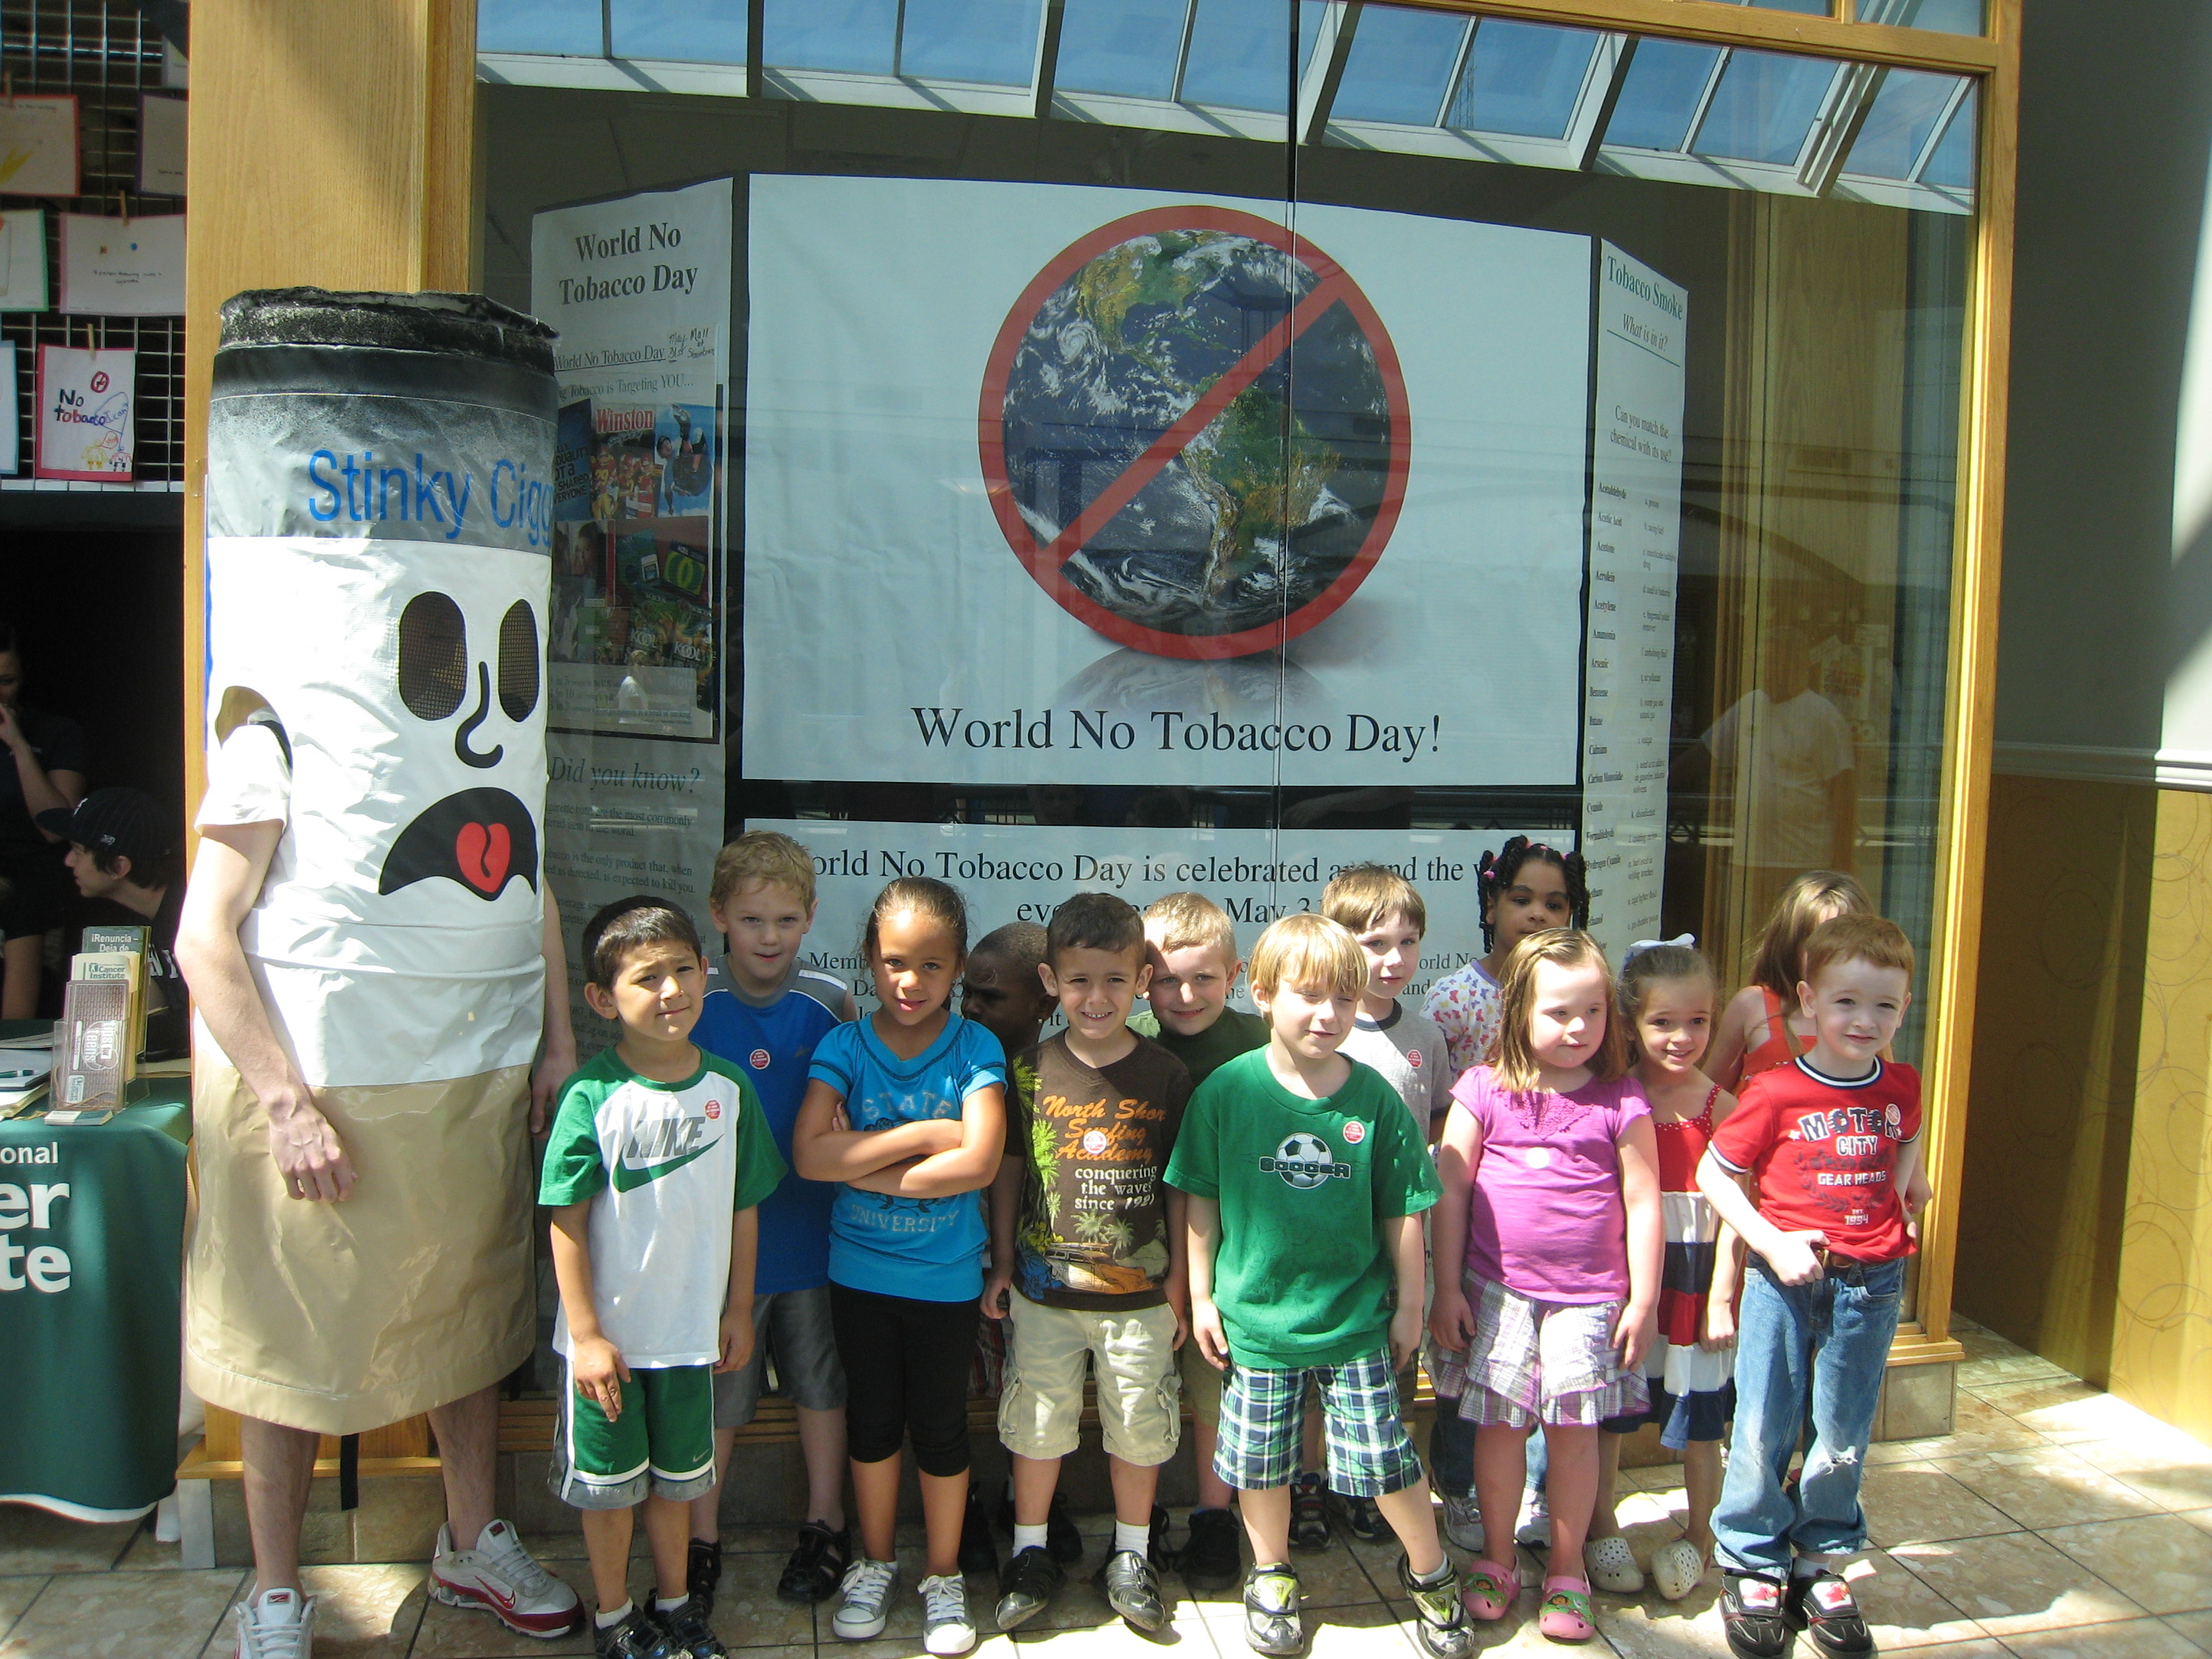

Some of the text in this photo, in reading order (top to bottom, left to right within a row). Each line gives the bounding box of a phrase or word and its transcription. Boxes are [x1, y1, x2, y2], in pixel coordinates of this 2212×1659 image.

[575, 222, 680, 262] World No
[559, 264, 698, 305] Tobacco Day
[1607, 256, 1683, 320] Tobacco Smoke
[1622, 313, 1669, 351] What is in it?
[554, 345, 666, 370] World No Tobacco Day
[59, 388, 84, 408] No
[570, 381, 604, 398] Tobacco
[607, 381, 614, 394] is
[617, 377, 659, 395] Targeting
[595, 408, 655, 432] Winston
[1615, 405, 1628, 423] Can
[1629, 411, 1640, 429] you
[1609, 428, 1637, 452] chemical
[308, 449, 471, 539] Stinky
[673, 641, 701, 662] KOOL
[910, 706, 1441, 764] World No Tobacco Day!
[552, 757, 701, 793] Did you know?
[595, 854, 613, 868] only
[616, 857, 647, 871] product
[813, 848, 869, 876] orld
[878, 849, 926, 878] No
[935, 852, 1064, 881] Tobacco
[1072, 854, 1128, 890] Day
[1142, 855, 1167, 882] is
[1175, 853, 1320, 884] celebrated
[1426, 856, 1464, 882] the
[613, 873, 649, 887] expected
[651, 877, 660, 888] to
[662, 878, 676, 890] kill
[1419, 953, 1451, 971] orld
[863, 1090, 954, 1120] STATE
[1043, 1095, 1107, 1118] North
[626, 1117, 706, 1159] NIKE
[1836, 1136, 1879, 1156] CITY
[0, 1141, 59, 1164] onal
[1074, 1164, 1158, 1186] conquering
[1817, 1170, 1887, 1186] GEAR HEADS
[1080, 1179, 1153, 1196] the waves
[0, 1182, 71, 1230] er
[1074, 1195, 1115, 1211] since
[851, 1203, 960, 1233] UNIVERSITY
[0, 1233, 71, 1293] te
